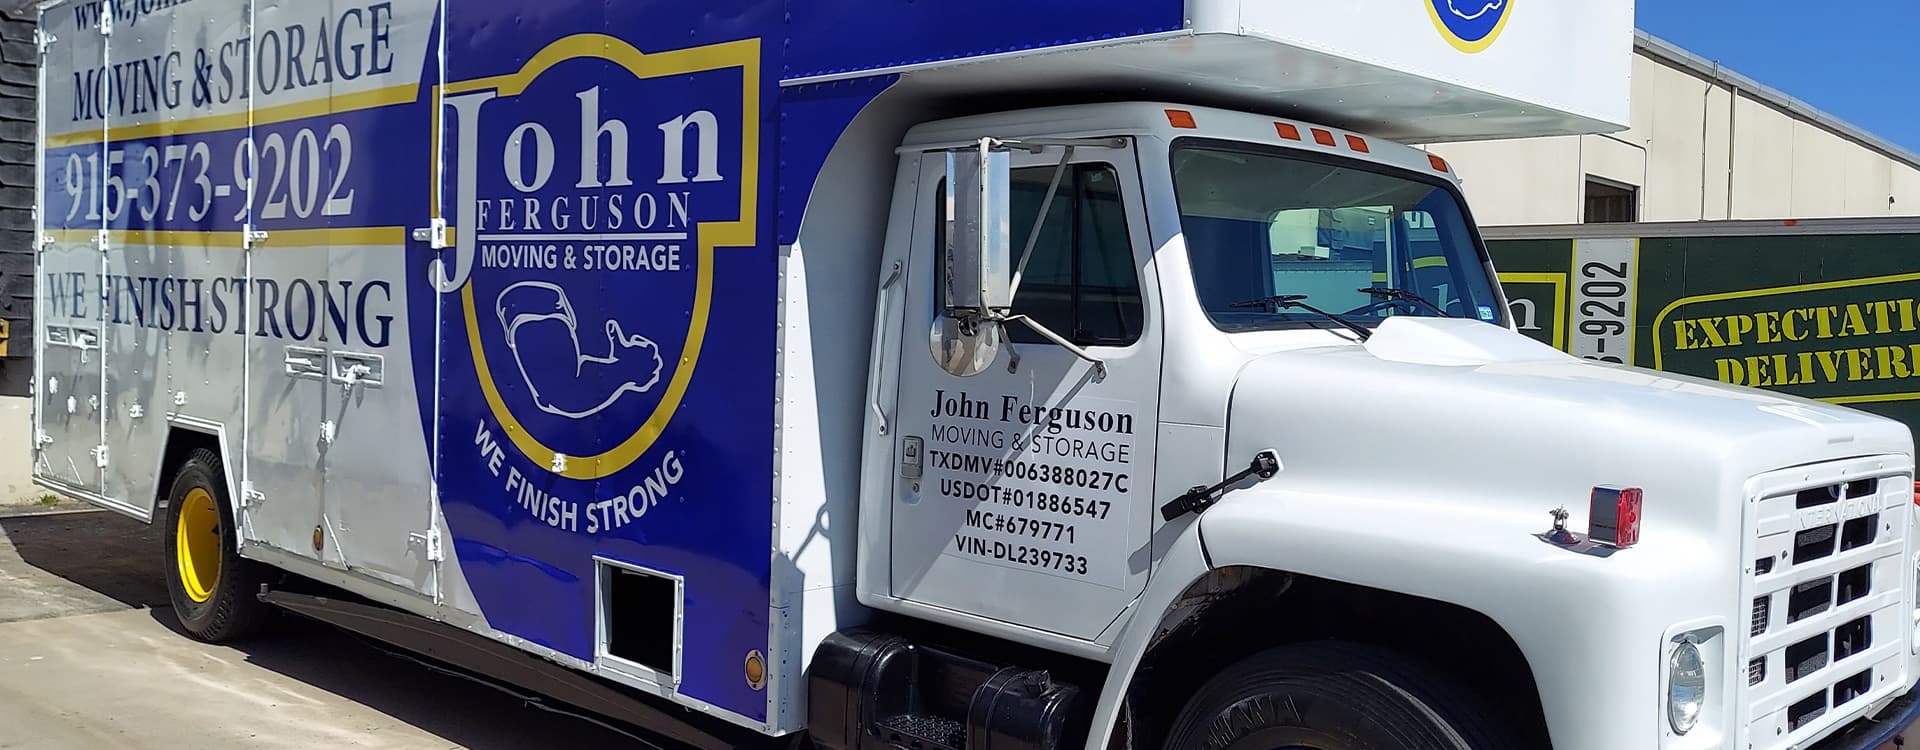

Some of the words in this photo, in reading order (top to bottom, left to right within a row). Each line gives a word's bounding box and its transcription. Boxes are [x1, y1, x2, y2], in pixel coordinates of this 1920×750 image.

[72, 50, 182, 121] MOVING
[192, 47, 213, 108] &
[218, 2, 394, 104] STORAGE
[65, 123, 355, 222] 915-373-9202
[428, 84, 724, 293] John
[476, 191, 691, 231] FERGUSON
[481, 245, 558, 269] MOVING
[563, 246, 577, 269] &
[583, 244, 681, 271] STORAGE
[47, 271, 88, 319] WE
[96, 273, 204, 334] FINISH
[209, 276, 395, 348] STRONG
[1672, 298, 1920, 350] EXPECTATI
[930, 389, 990, 420] John
[1000, 395, 1133, 435] Ferguson
[931, 423, 1004, 450] MOVING
[1012, 432, 1025, 452] &
[1031, 434, 1131, 464] STORAGE
[474, 418, 506, 478] WE
[505, 465, 578, 532] FINISH
[585, 450, 684, 534] STRONG
[929, 450, 1129, 493] TXDMV#006388027C
[940, 478, 1111, 520] USDOT#01886547
[966, 509, 1075, 544] MC#679771
[955, 534, 1088, 575] VIN-DL239733
